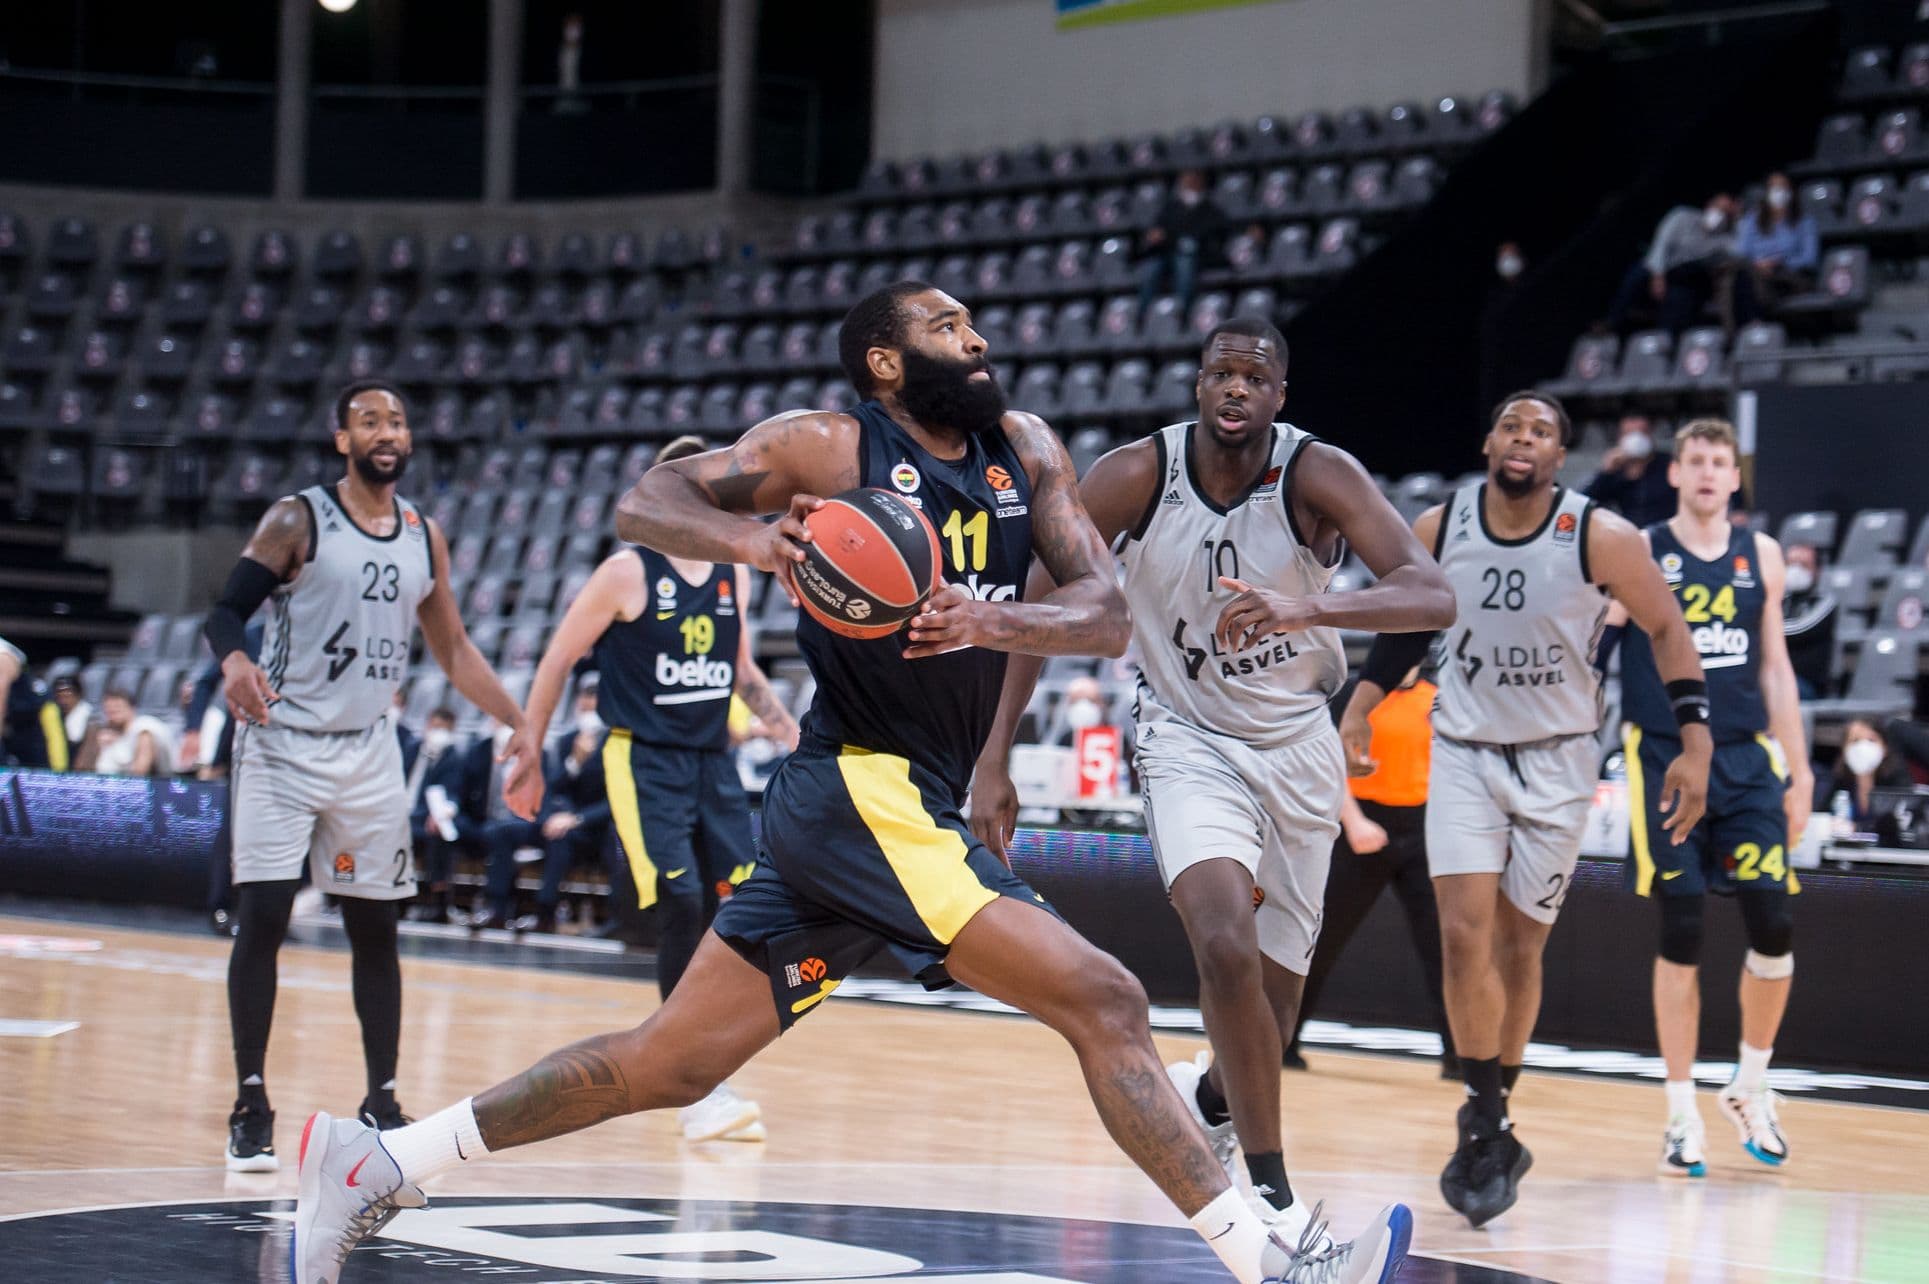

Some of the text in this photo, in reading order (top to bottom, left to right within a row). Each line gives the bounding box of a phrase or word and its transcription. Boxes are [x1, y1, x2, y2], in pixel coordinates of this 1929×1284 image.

[941, 509, 989, 572] 11
[362, 561, 400, 603] 23
[1204, 539, 1239, 592] 10
[807, 578, 842, 610] TURKISH
[1481, 567, 1526, 612] 28
[1682, 583, 1738, 623] 24
[679, 614, 715, 655] 19
[1692, 620, 1749, 655] eko
[655, 652, 733, 688] beko
[1222, 640, 1299, 679] ASVEL
[1493, 644, 1564, 669] LDLC
[1496, 669, 1565, 687] ASVEL
[1082, 732, 1114, 783] 5
[392, 848, 415, 888] 2
[1733, 842, 1787, 882] 24
[1536, 873, 1571, 911] 2
